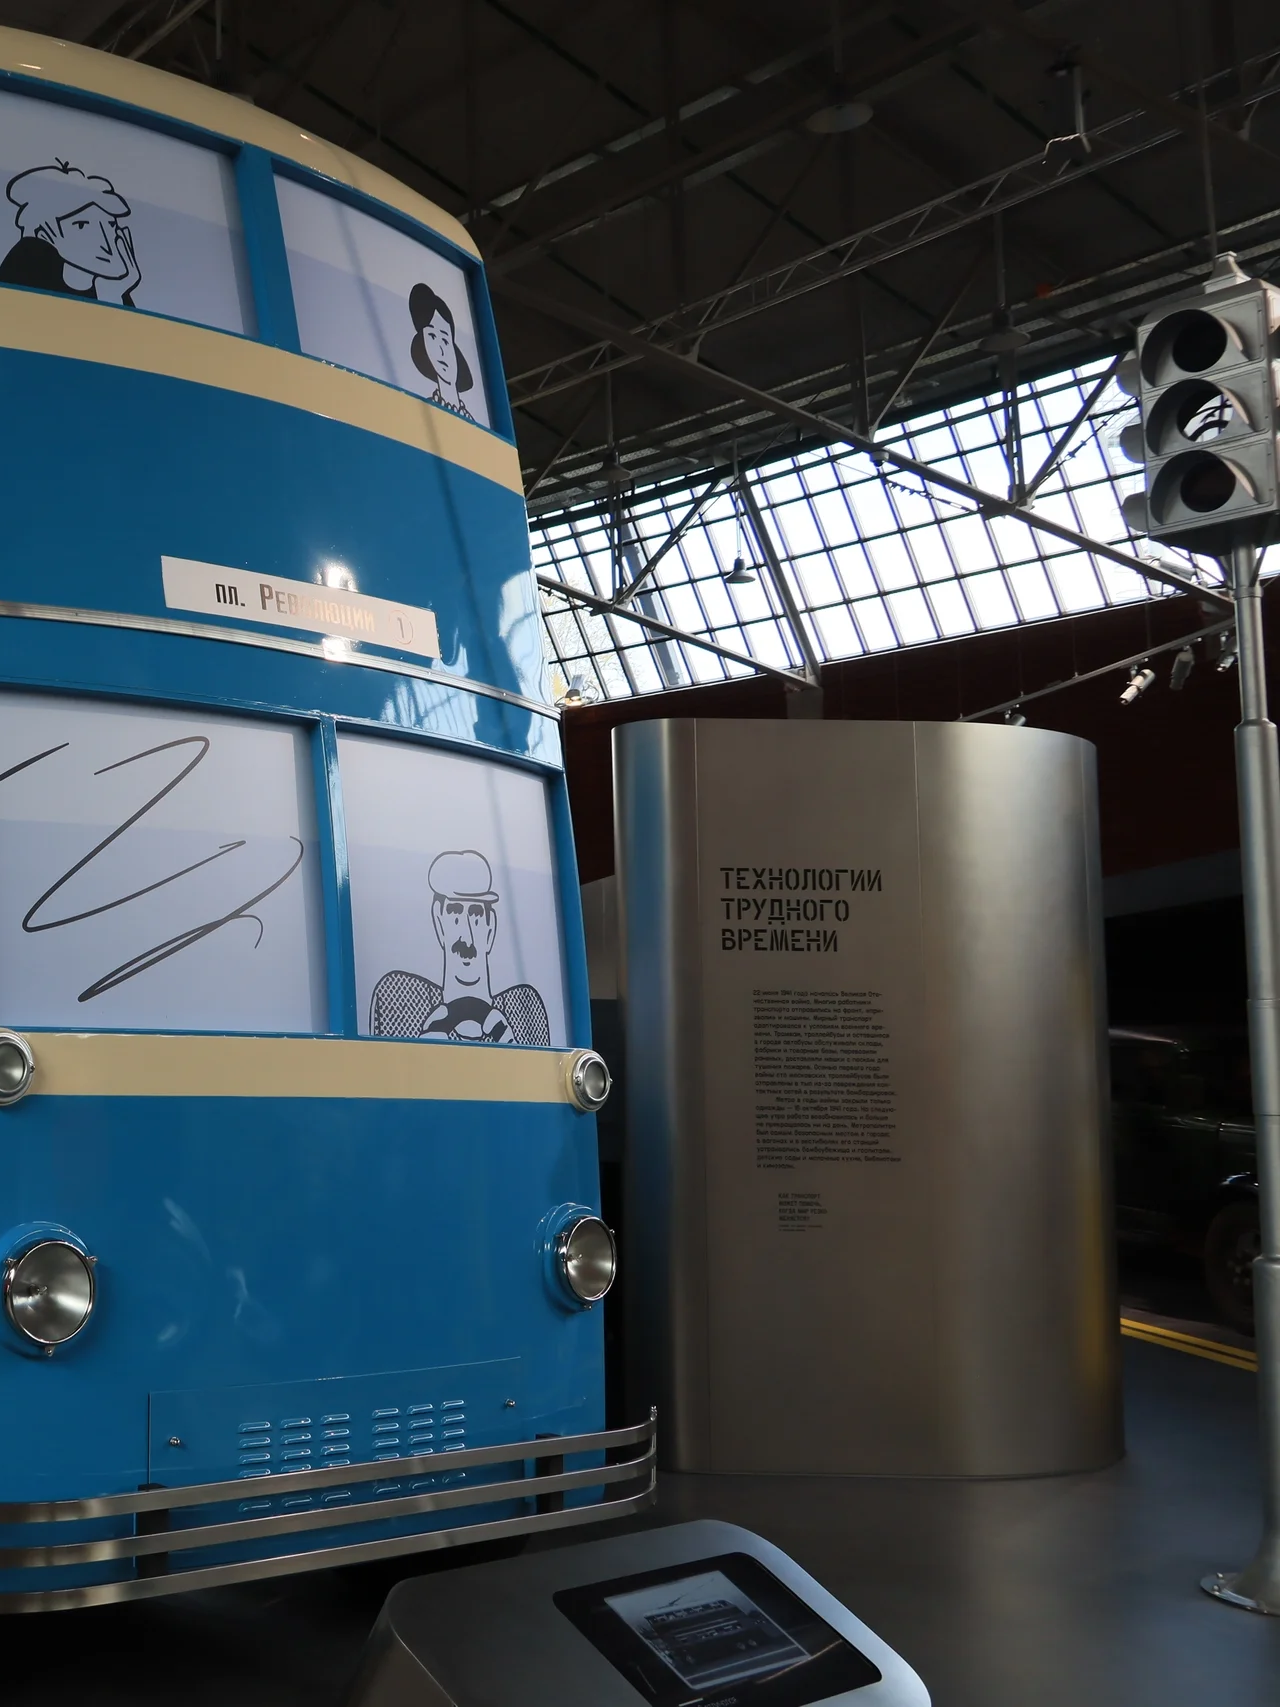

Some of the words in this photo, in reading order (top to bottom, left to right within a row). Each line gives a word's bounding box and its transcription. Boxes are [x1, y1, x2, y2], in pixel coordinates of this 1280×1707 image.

[720, 868, 882, 891] ТЕХНОЛОГИИ
[720, 898, 850, 925] ТРУДНОГО
[721, 928, 838, 952] ВРЕМЕНИ
